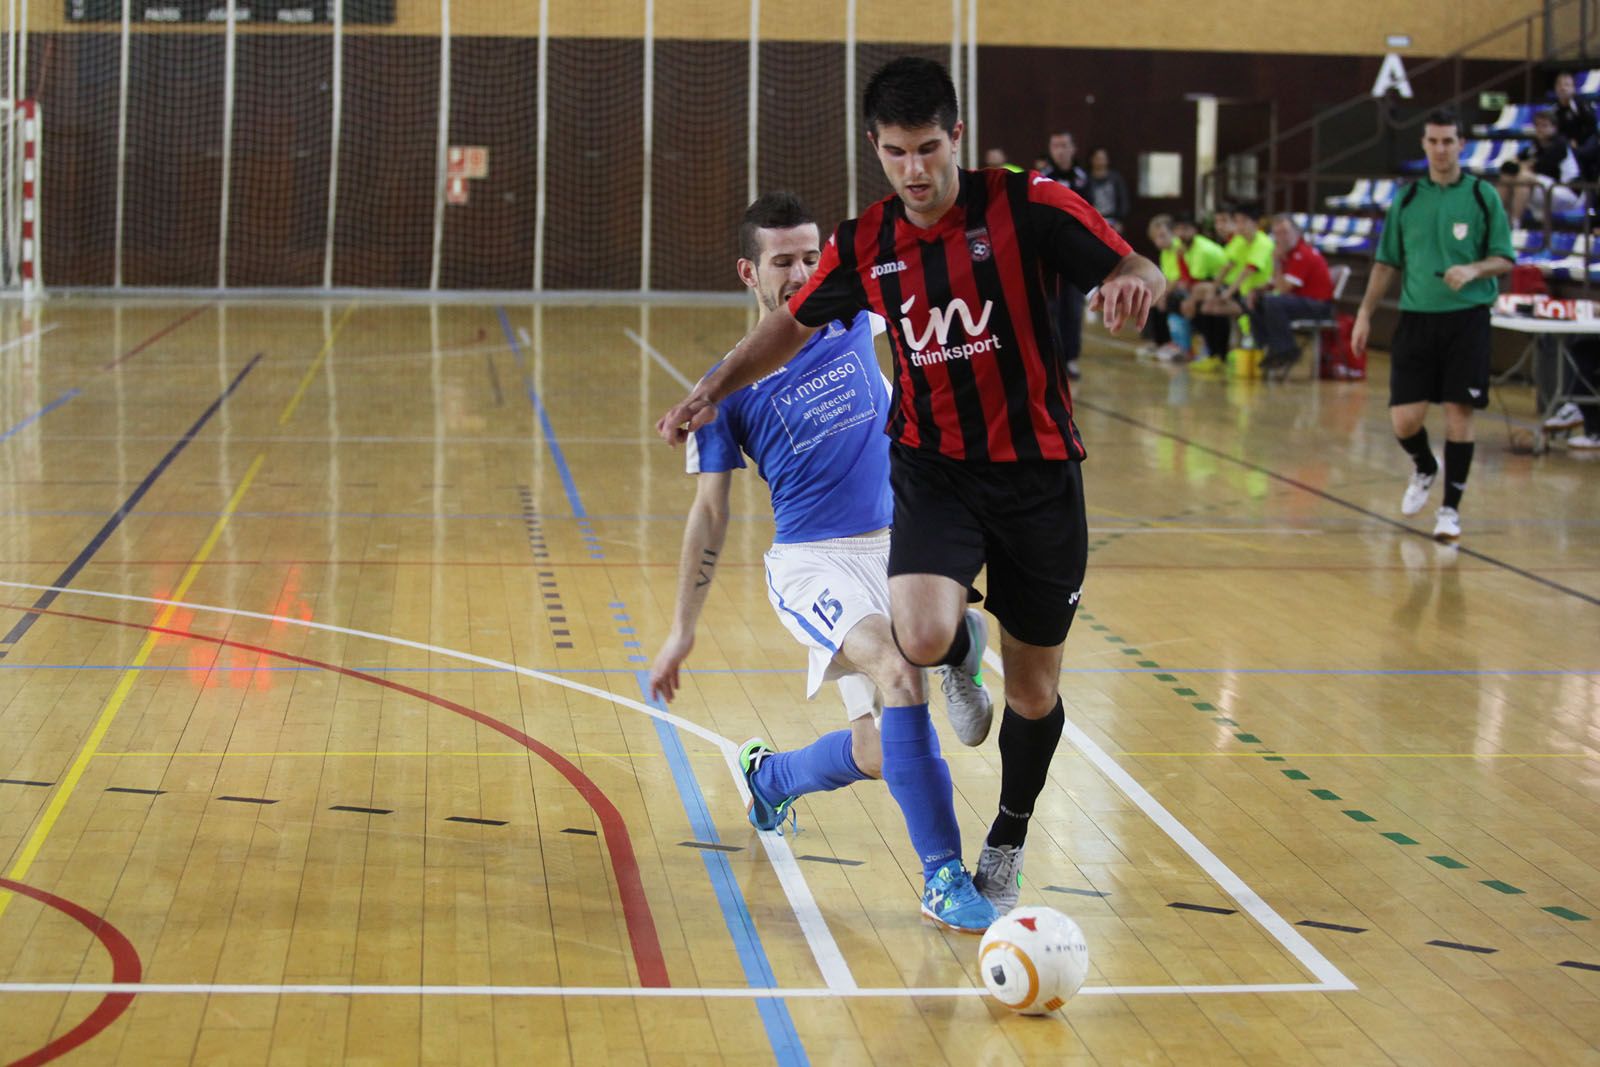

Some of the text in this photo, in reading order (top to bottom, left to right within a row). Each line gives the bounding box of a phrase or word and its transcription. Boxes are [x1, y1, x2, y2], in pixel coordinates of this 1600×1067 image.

[1372, 53, 1413, 98] A
[911, 334, 1002, 368] thinksport
[803, 388, 857, 421] arquitectura
[820, 402, 852, 423] disseny
[811, 588, 844, 631] 15
